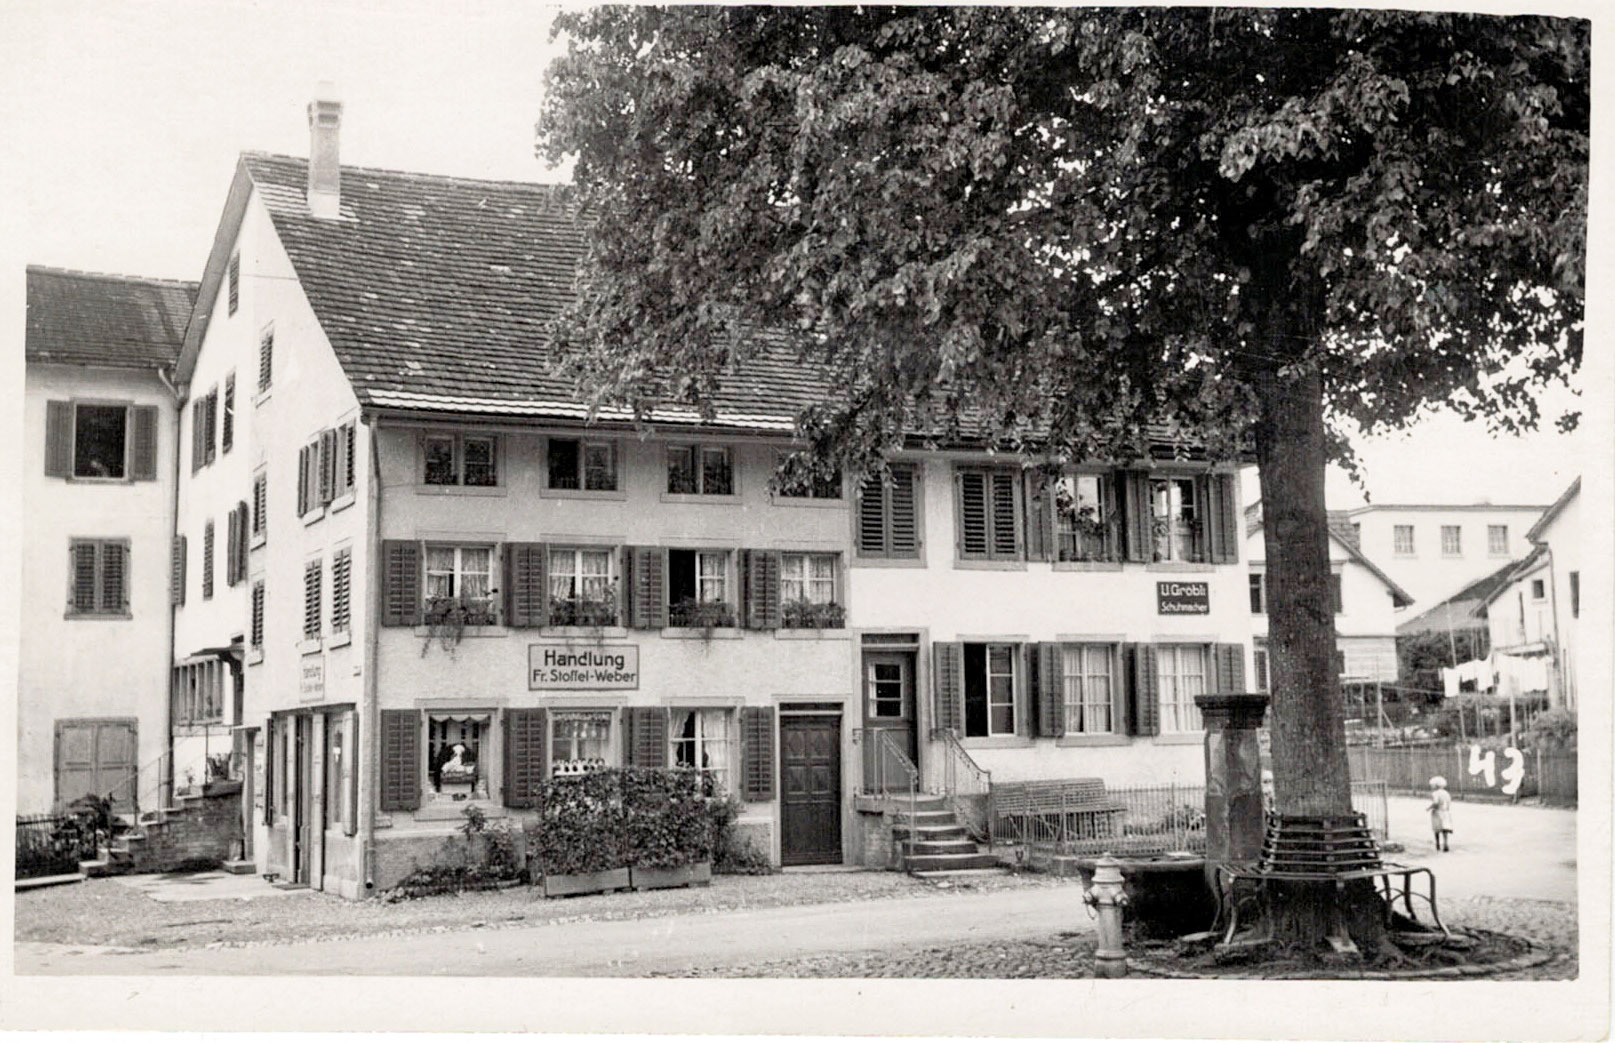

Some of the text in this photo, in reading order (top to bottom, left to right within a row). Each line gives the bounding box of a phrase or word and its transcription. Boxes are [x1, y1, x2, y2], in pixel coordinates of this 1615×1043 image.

[544, 649, 625, 671] Handlung
[532, 669, 637, 683] Fr. Stoffel-Weber
